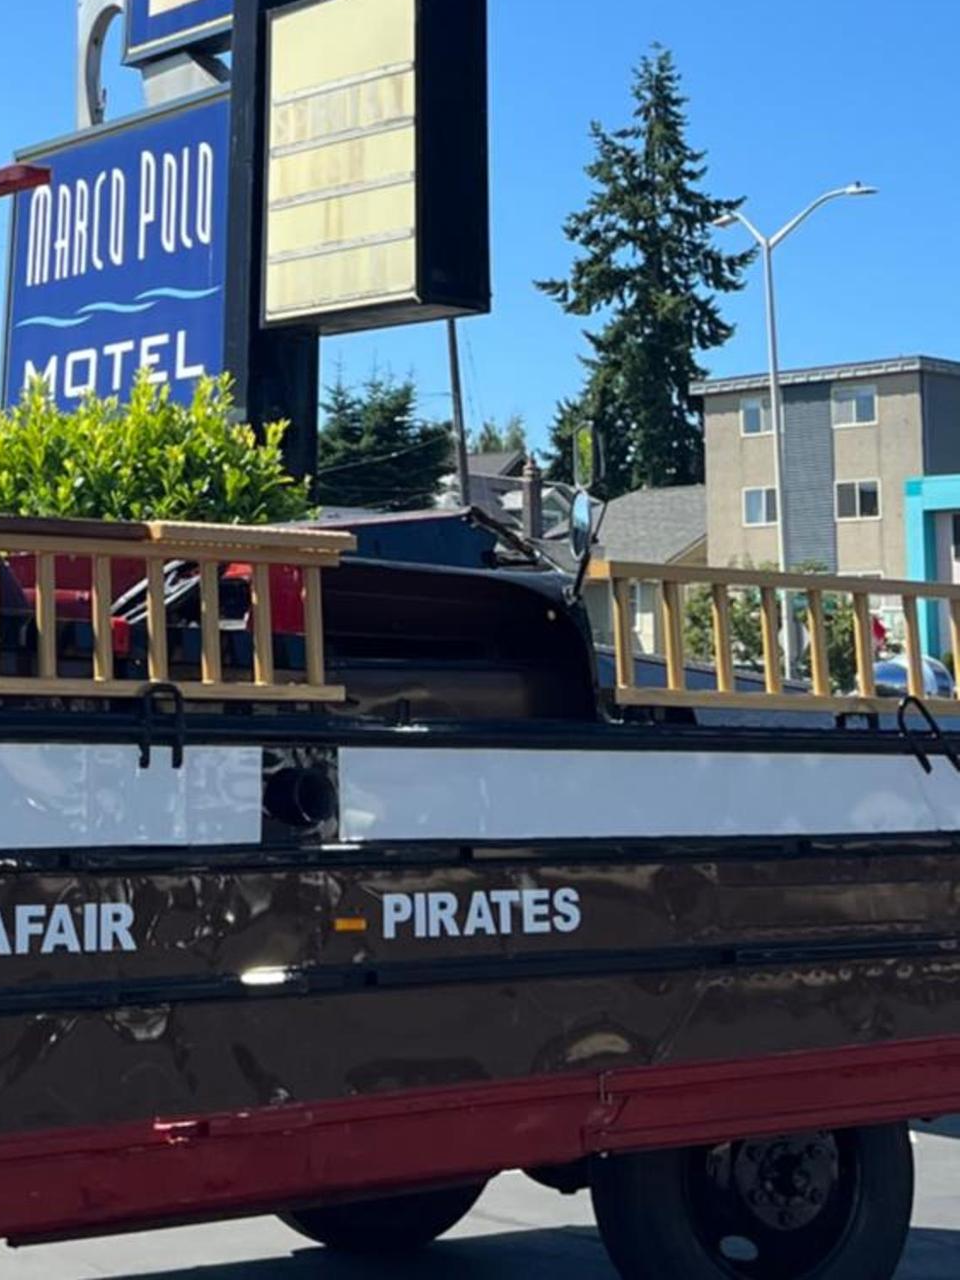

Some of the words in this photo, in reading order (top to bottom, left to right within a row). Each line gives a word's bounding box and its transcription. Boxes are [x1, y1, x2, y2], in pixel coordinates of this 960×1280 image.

[26, 168, 125, 287] MARCO
[138, 141, 213, 260] POLO
[24, 330, 204, 400] MOTEL
[382, 887, 581, 939] PIRATES
